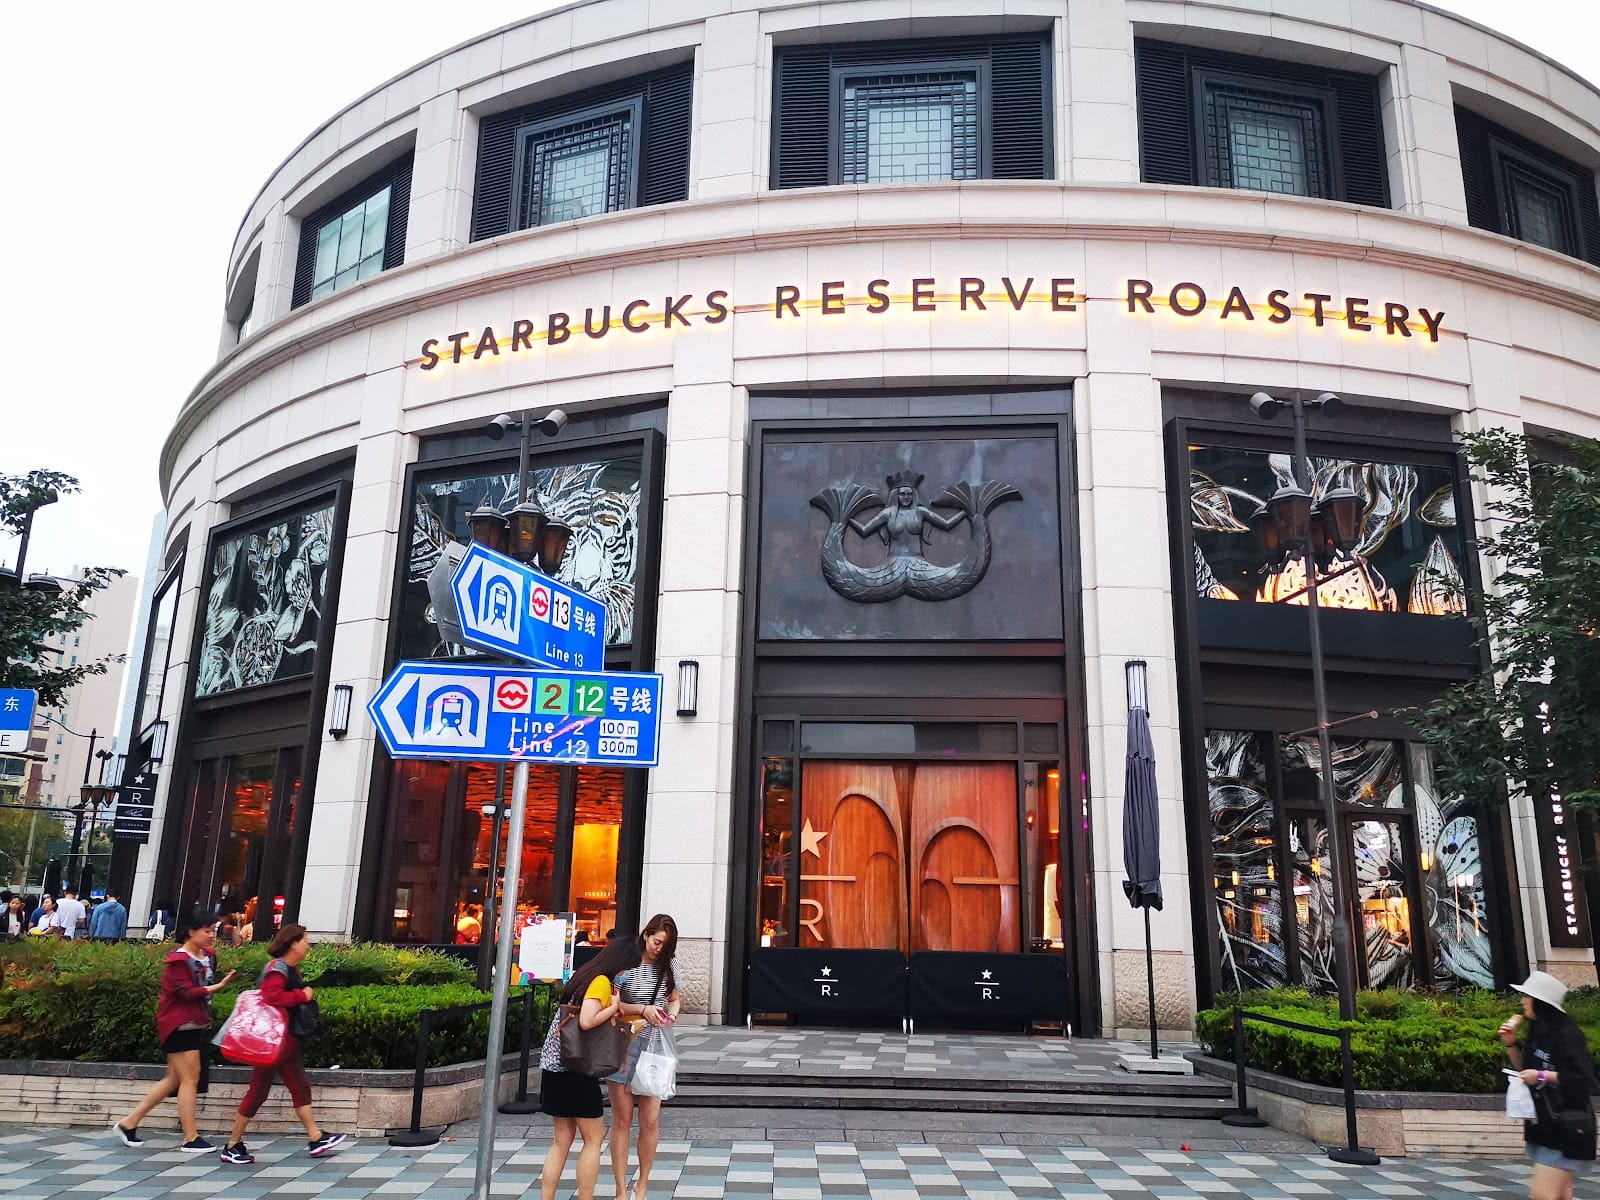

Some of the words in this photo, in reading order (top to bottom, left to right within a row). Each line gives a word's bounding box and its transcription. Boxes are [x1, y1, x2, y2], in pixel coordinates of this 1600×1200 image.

[420, 290, 728, 370] STARBUCKS
[775, 277, 1077, 319] RESERVE
[1127, 279, 1446, 343] ROASTERY
[554, 598, 570, 627] 13
[572, 606, 597, 637] 号线
[545, 642, 570, 663] Line
[573, 652, 584, 668] 13
[3, 696, 20, 712] 东
[543, 683, 563, 709] 2
[576, 686, 604, 713] 12
[609, 687, 652, 714] 号线
[511, 717, 555, 734] Line
[573, 721, 585, 736] 2
[602, 722, 637, 735] 100m
[0, 734, 11, 747] E
[509, 735, 553, 754] Line
[566, 739, 588, 755] 12
[600, 741, 636, 755] 300m
[131, 792, 142, 803] R
[1556, 836, 1578, 936] STARBUCKS
[799, 898, 824, 942] R
[821, 984, 831, 997] R
[982, 987, 993, 1000] R
